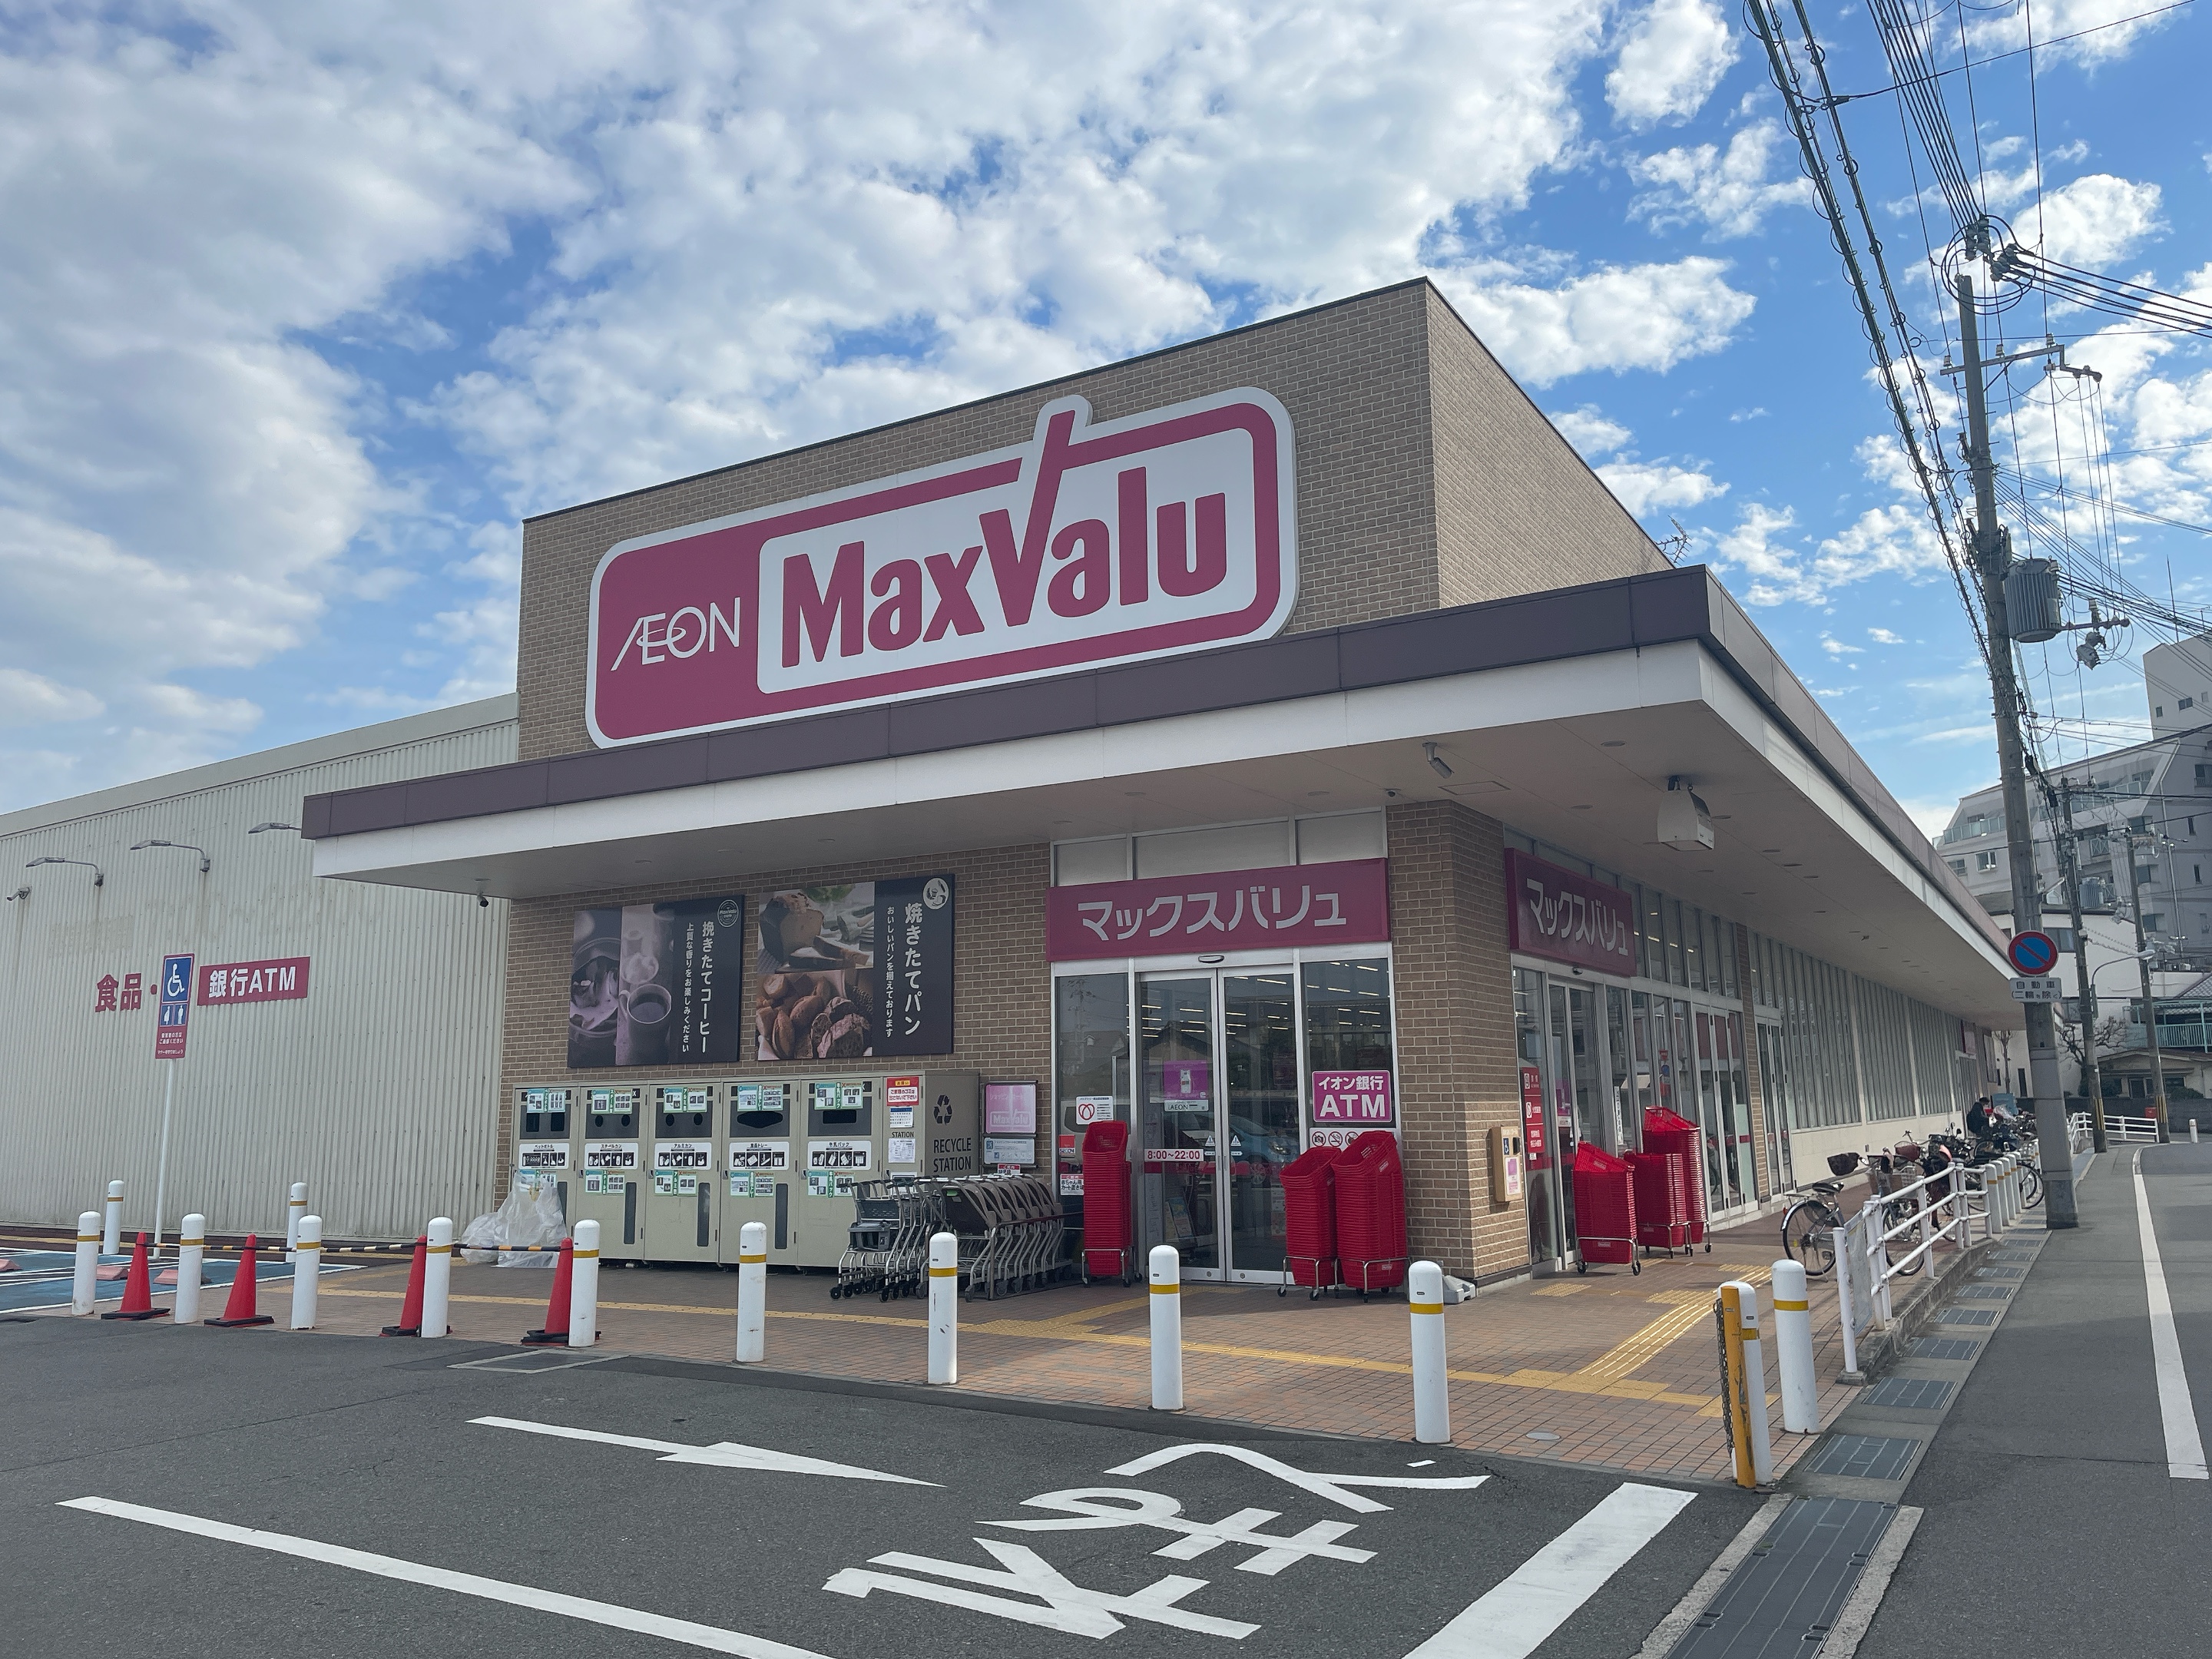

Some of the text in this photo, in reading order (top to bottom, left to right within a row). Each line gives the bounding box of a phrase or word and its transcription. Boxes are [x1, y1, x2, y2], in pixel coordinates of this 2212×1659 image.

[781, 410, 1227, 667] MaxValu
[1077, 884, 1347, 942] マックスバリュ
[1525, 877, 1629, 957] マックスバリュ
[208, 966, 296, 998] 銀行ATM
[682, 922, 694, 1052] 上質な香りをお楽しみください
[700, 921, 715, 1053] 挽きたてコーヒー
[886, 906, 895, 1037] おいしいパンを揃えております
[905, 902, 923, 1035] 焼きたてパン
[2016, 981, 2055, 989] 自動車
[1318, 1075, 1384, 1091] イオン銀行
[1320, 1094, 1386, 1118] ATM
[933, 1137, 972, 1154] RECYCLE
[933, 1156, 972, 1173] STATION
[822, 1443, 1492, 1640] とまれ
